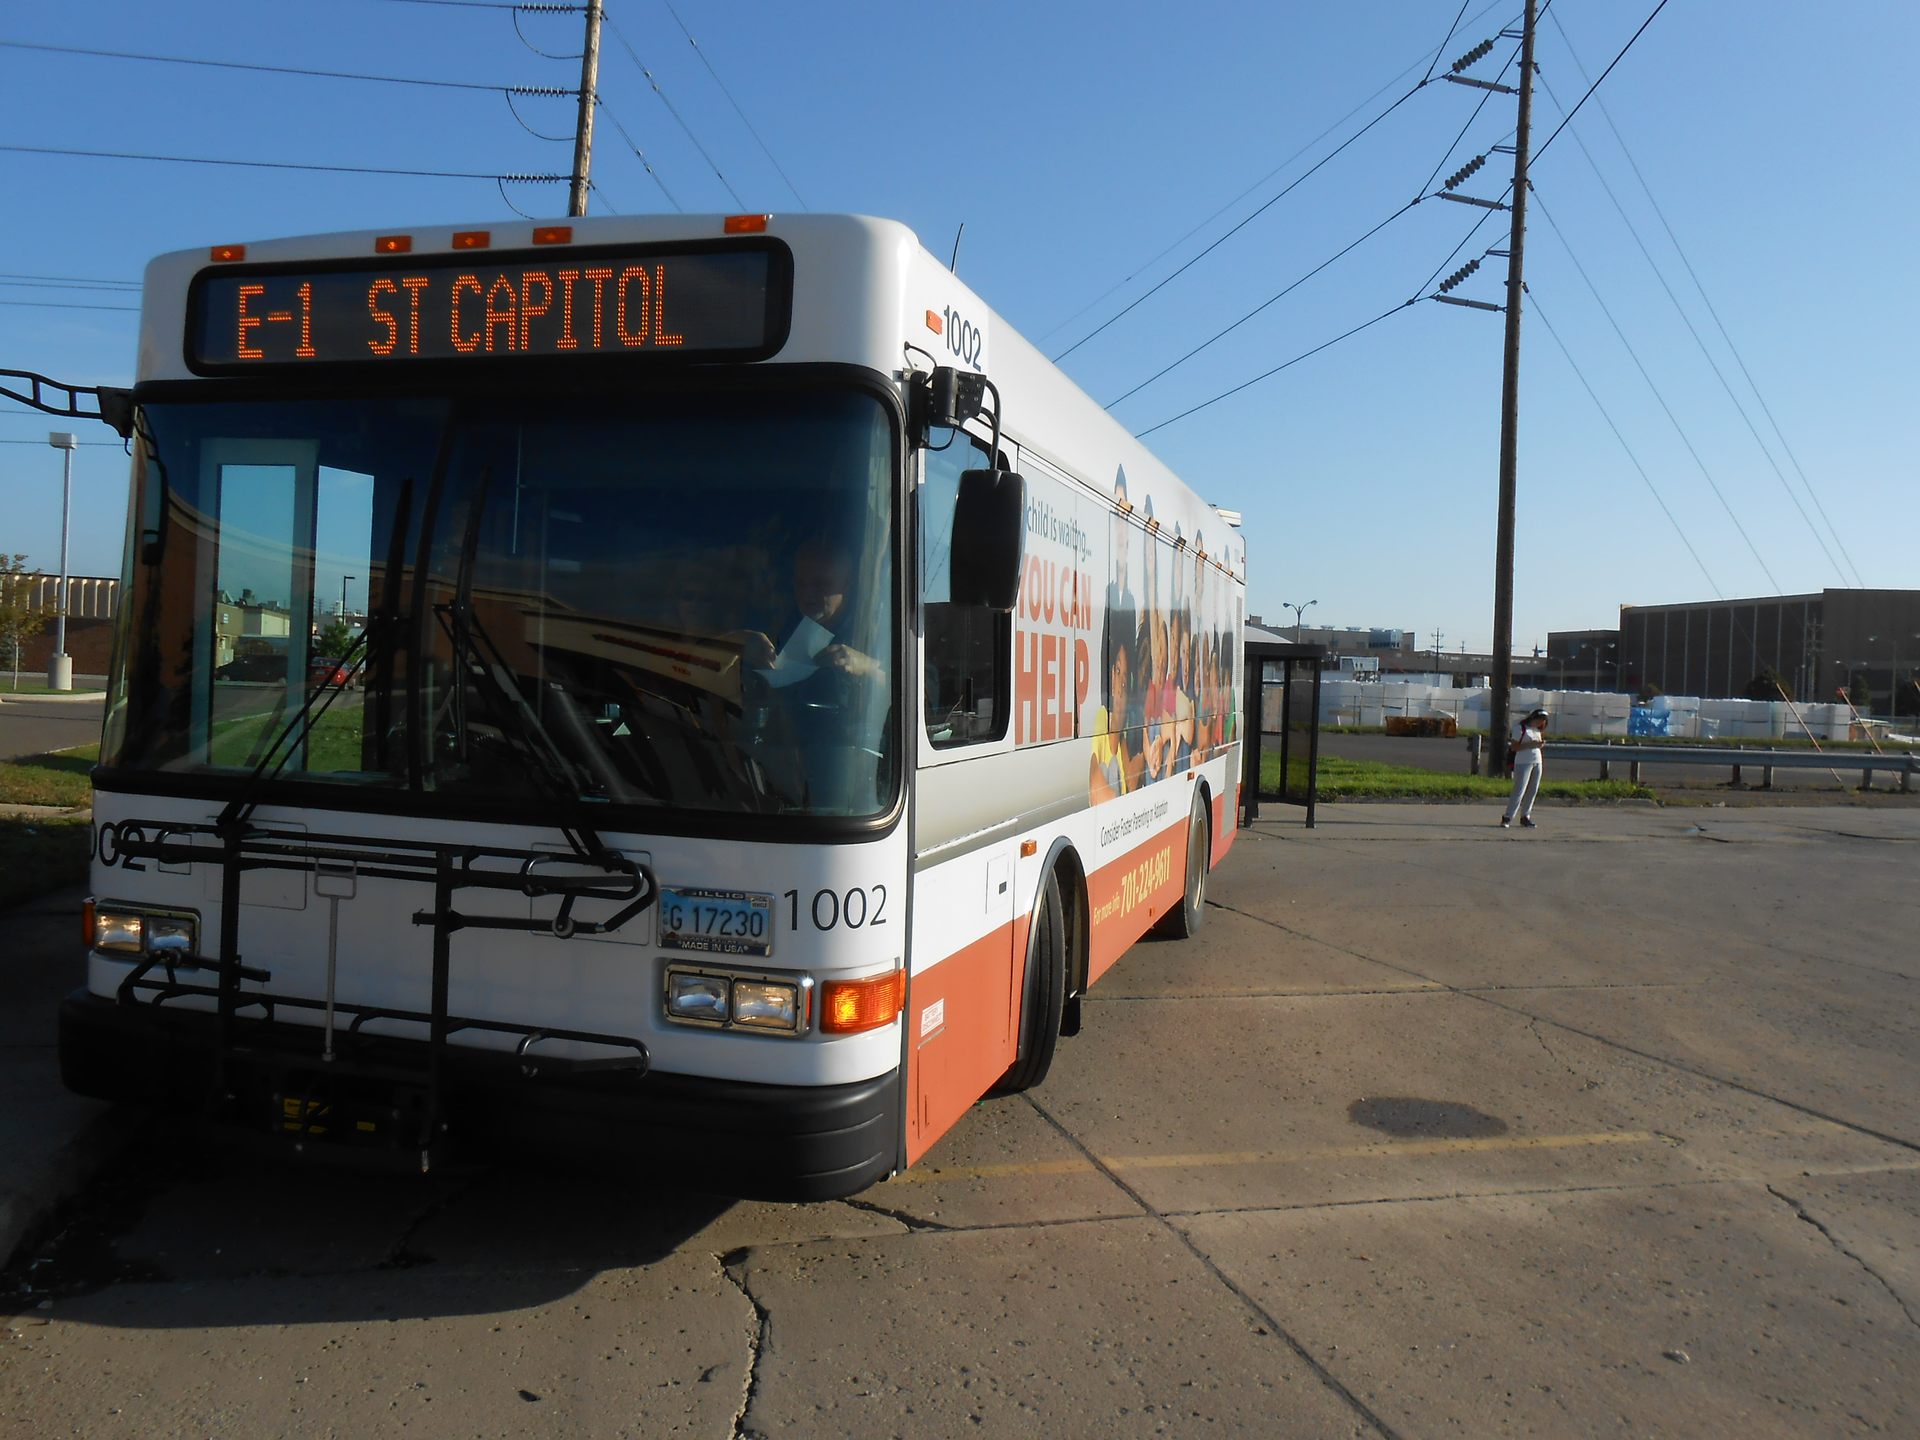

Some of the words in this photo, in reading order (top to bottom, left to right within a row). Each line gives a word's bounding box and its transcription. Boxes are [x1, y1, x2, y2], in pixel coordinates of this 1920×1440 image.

[236, 281, 317, 360] E-1
[366, 276, 429, 356] ST
[449, 264, 684, 354] CAPITOL
[943, 304, 982, 373] 1002
[1026, 496, 1049, 537] child
[1050, 509, 1057, 542] is
[1059, 565, 1092, 631] CAN
[1015, 630, 1091, 746] HELP
[1100, 820, 1121, 848] Consider
[783, 884, 888, 932] 1002
[1093, 907, 1101, 927] For
[1120, 845, 1171, 918] 701-224-9611
[670, 905, 683, 931] G
[693, 906, 763, 938] 17230
[681, 940, 709, 951] MADE
[712, 943, 722, 952] IN
[724, 945, 744, 954] USA
